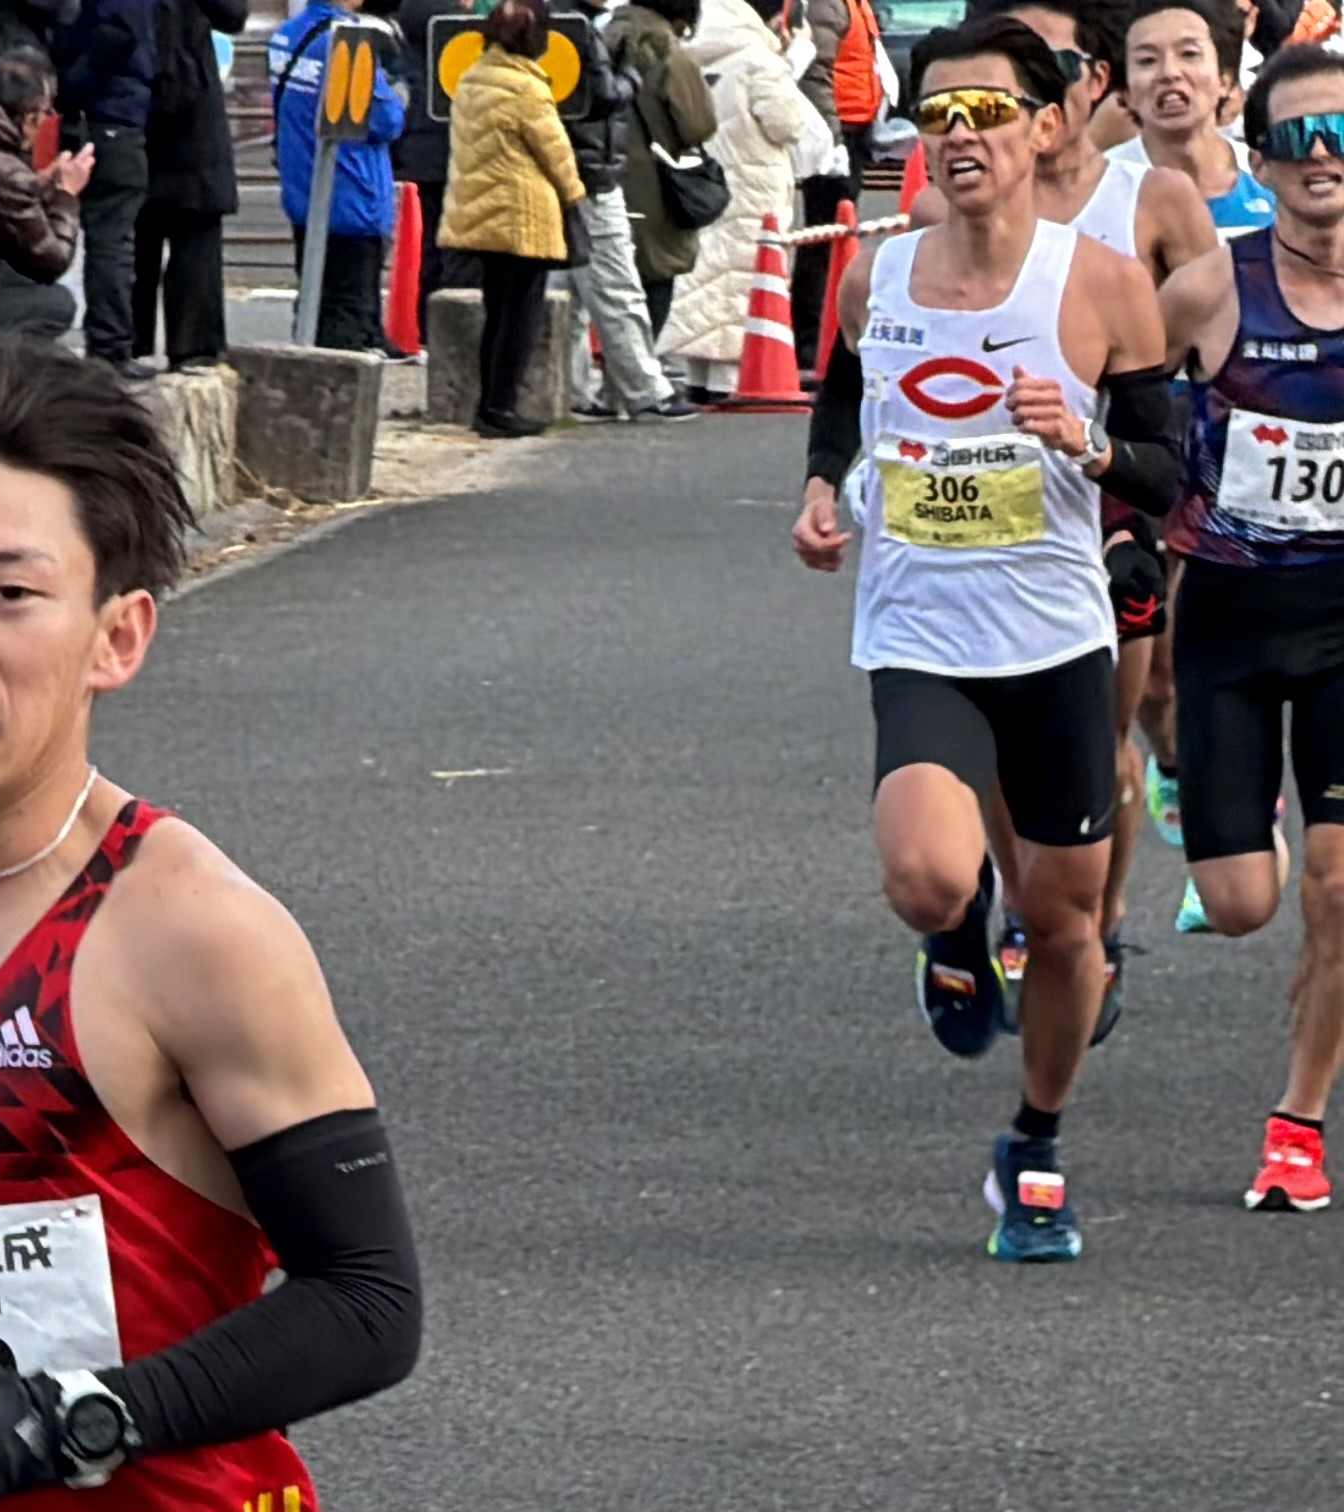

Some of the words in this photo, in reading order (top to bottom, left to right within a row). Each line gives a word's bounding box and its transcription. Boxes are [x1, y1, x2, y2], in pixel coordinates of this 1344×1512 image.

[924, 473, 980, 502] 306
[1267, 456, 1344, 503] 130
[914, 502, 993, 522] SHIBATA
